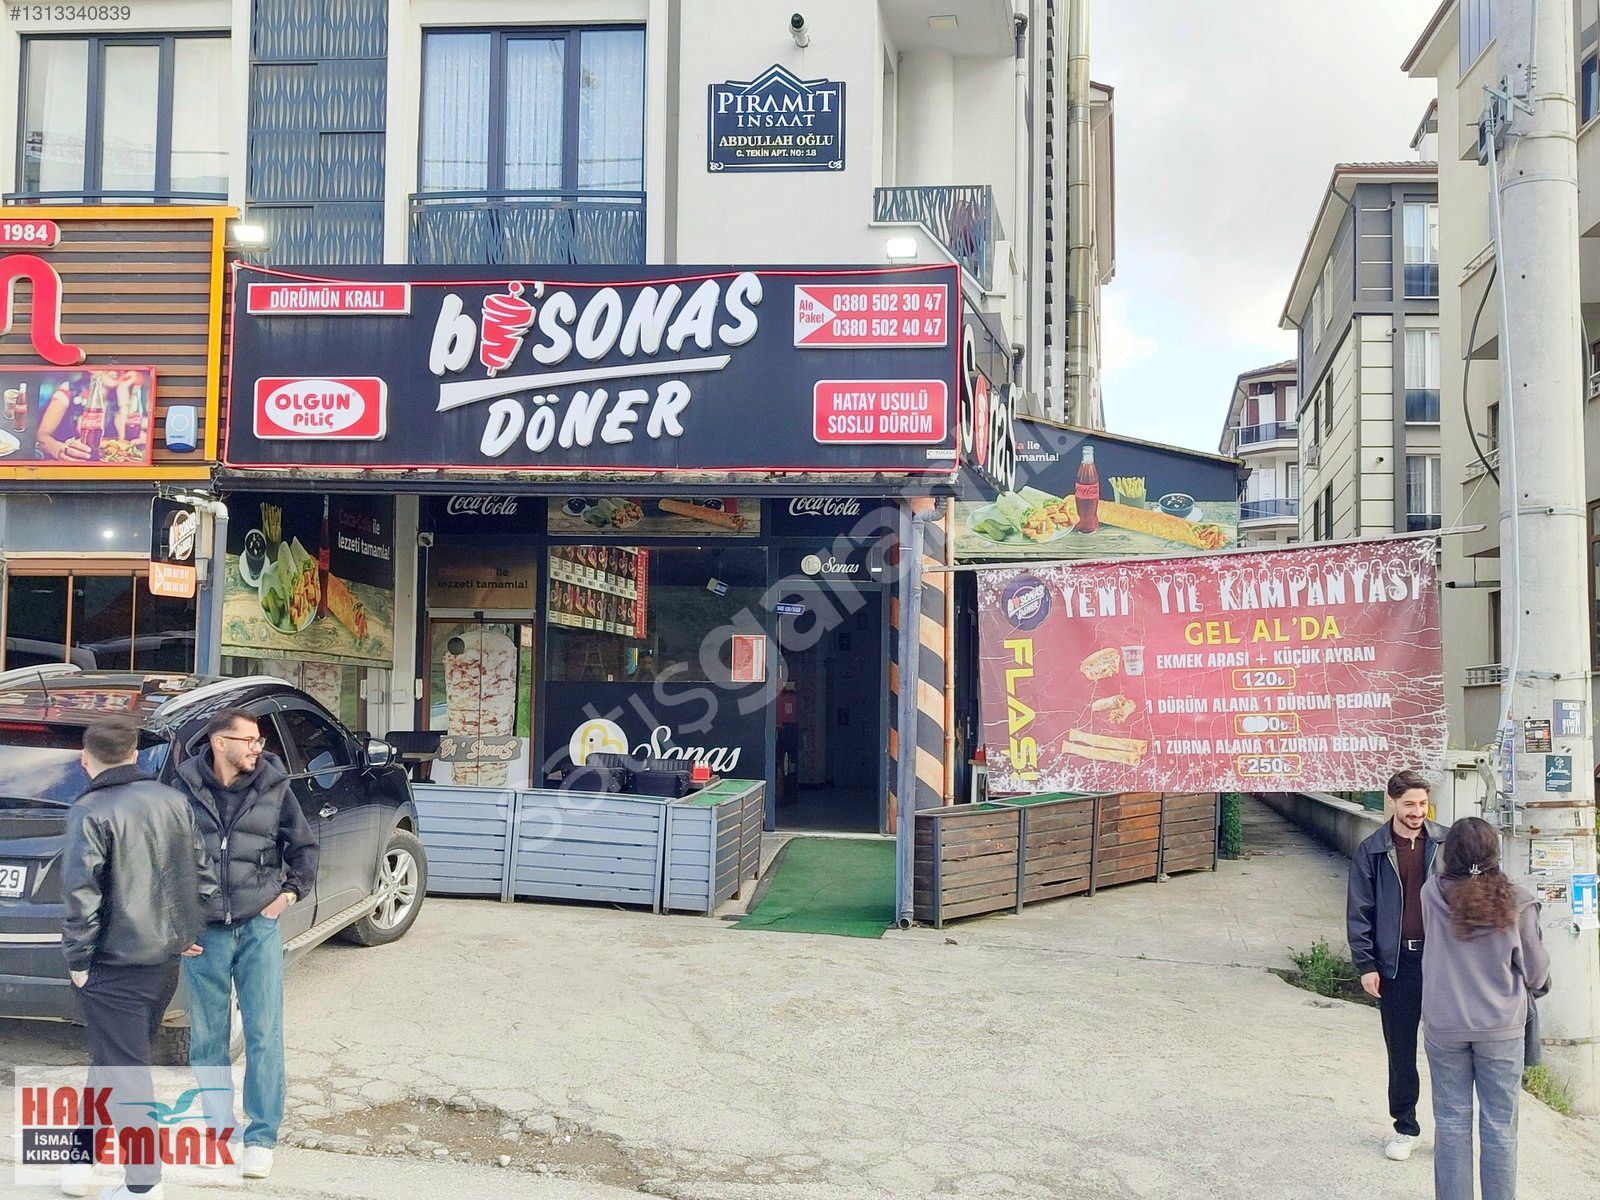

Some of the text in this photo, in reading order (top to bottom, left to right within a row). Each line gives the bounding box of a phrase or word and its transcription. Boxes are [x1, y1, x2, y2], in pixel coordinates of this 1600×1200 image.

[737, 114, 816, 127] INSAAT
[719, 133, 834, 147] ABDULLAH OĞLU
[736, 148, 817, 157] C. TEKİN APT. NO: 18
[3, 224, 48, 241] 1984
[270, 288, 385, 308] DÜRÜMÜN KRALI
[799, 299, 815, 312] Alo
[833, 293, 942, 312] 0380 502 30 47
[799, 311, 825, 324] Paket
[833, 319, 942, 337] 0380 502 40 47
[274, 393, 350, 410] OLGUN
[833, 389, 928, 411] HATAY USULÜ
[480, 380, 692, 458] DÖNER
[828, 411, 933, 433] SOSLU DÜRÜM
[338, 531, 390, 560] lezzeti tamamla!
[821, 556, 860, 573] Sonas
[1218, 557, 1421, 611] KAMPANYASI
[1184, 615, 1342, 646] GEL AL'DA
[1156, 653, 1204, 669] EKMEK
[1207, 651, 1250, 668] ARASI
[1256, 652, 1268, 666] +
[1273, 646, 1320, 669] KÜÇÜK
[1325, 645, 1376, 662] AYRAN
[1146, 691, 1393, 713] 1 DÜRÜM ALANA 1 DÜRÜM BEDAVA
[1153, 735, 1389, 755] 1 ZURNA ALANA 1 ZURNA BEDAVA
